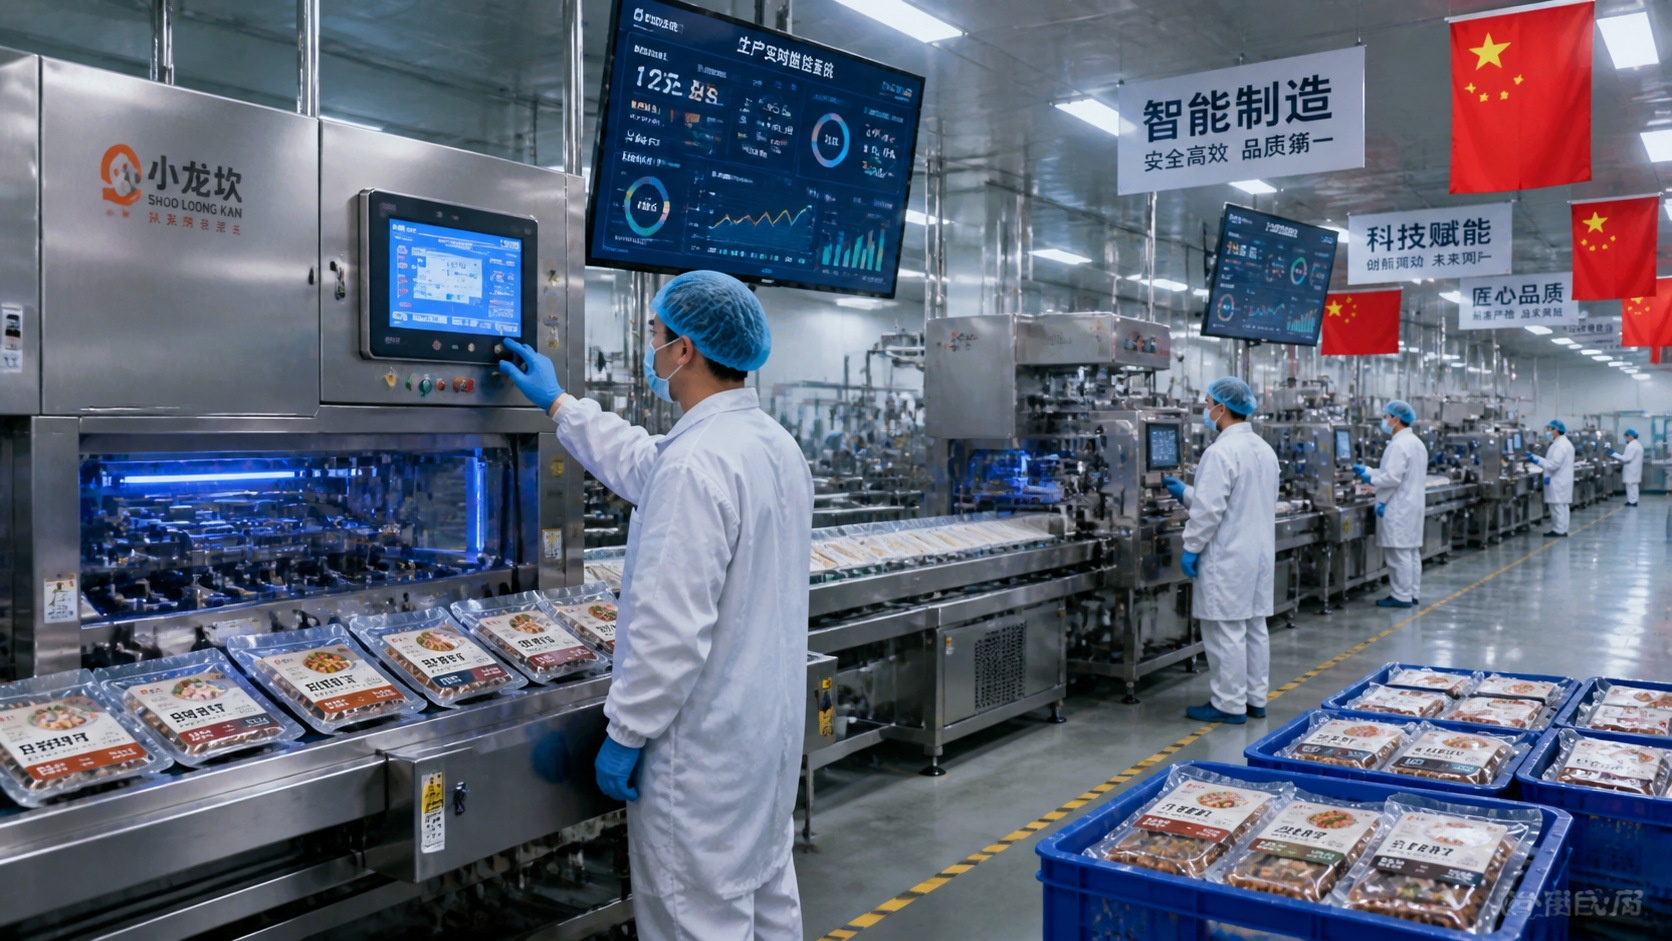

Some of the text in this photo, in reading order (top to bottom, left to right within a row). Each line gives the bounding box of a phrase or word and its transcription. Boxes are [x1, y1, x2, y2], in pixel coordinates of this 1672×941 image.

[1143, 74, 1333, 144] 智能制造
[1144, 144, 1229, 172] 安全高效
[147, 155, 243, 203] 小龙坎
[220, 205, 243, 219] KAN
[1366, 217, 1492, 253] 科技赋能
[1472, 282, 1564, 307] 匠心品质
